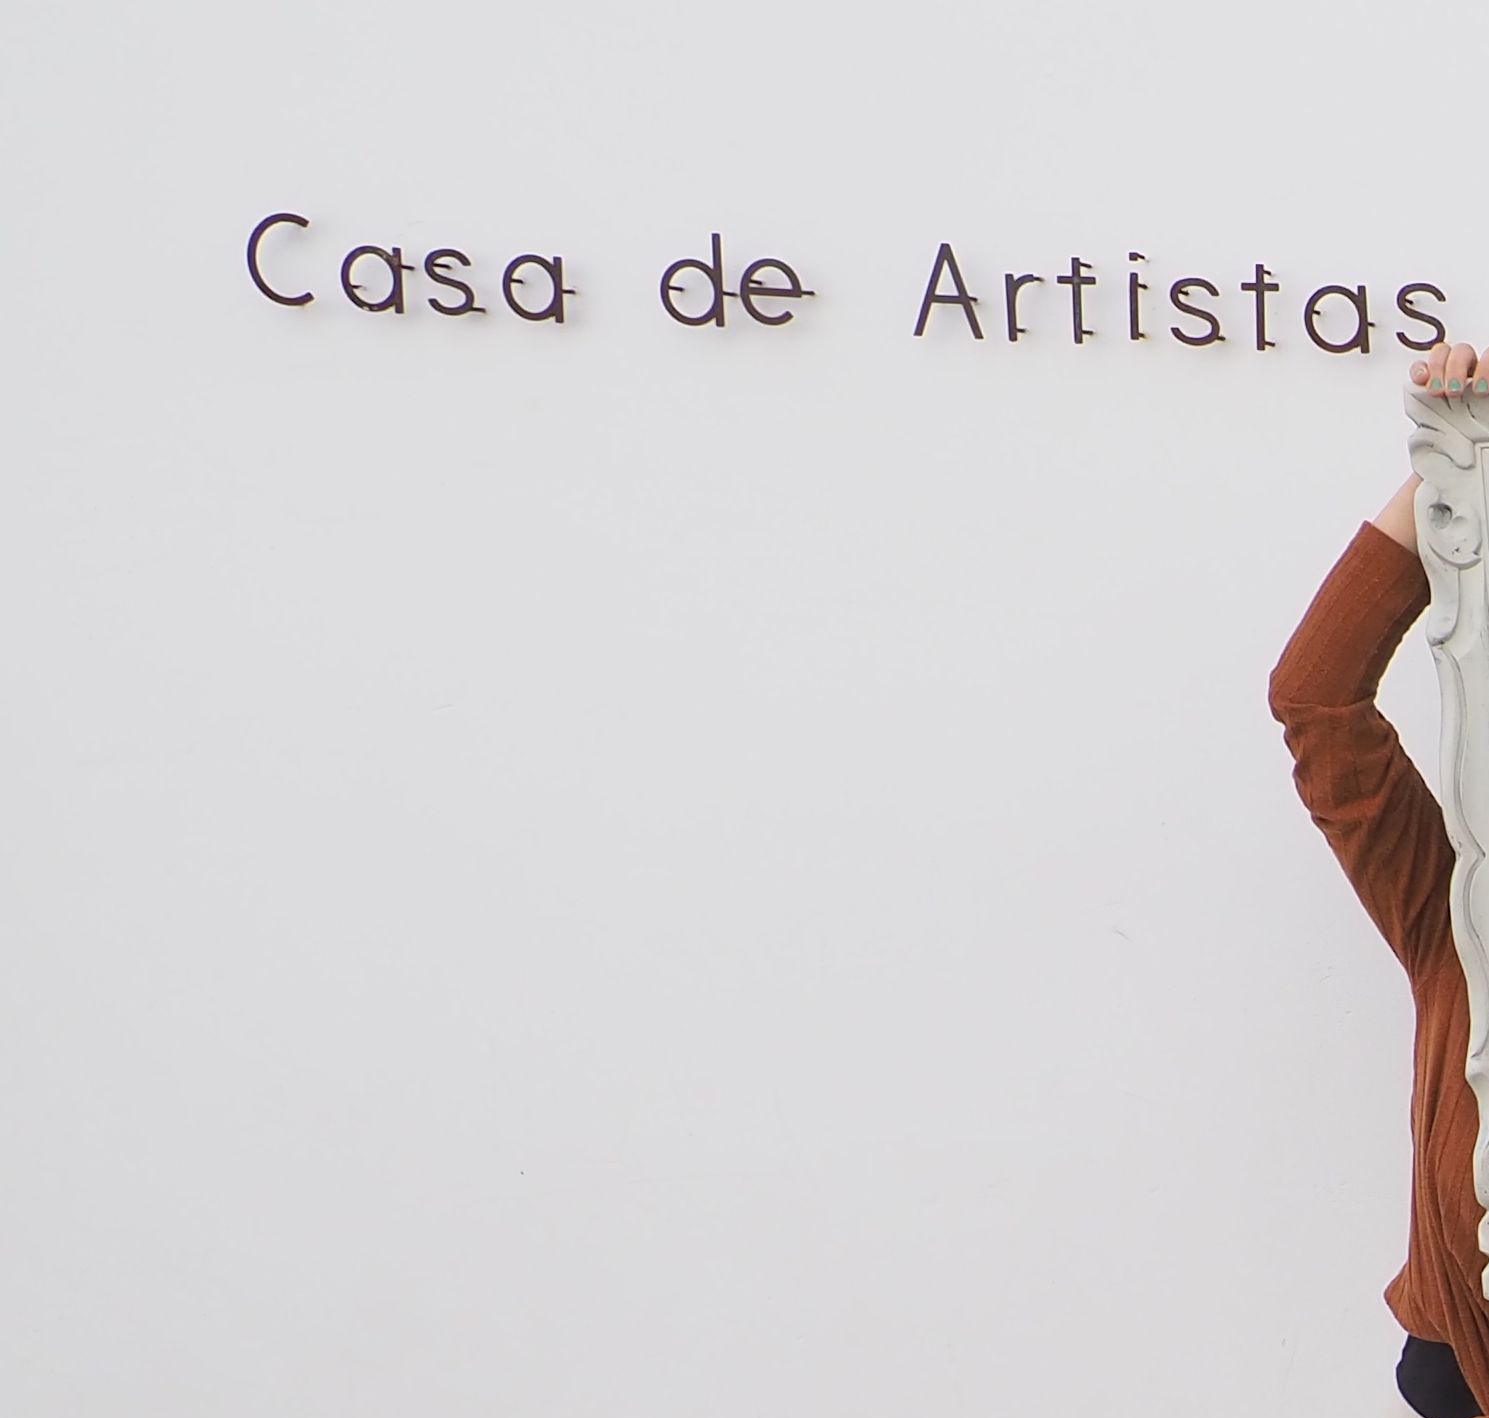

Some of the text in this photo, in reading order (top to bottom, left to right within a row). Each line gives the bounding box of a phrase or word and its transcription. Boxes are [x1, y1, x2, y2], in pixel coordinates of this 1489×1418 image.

[246, 211, 1448, 354] Casa de Artistas
